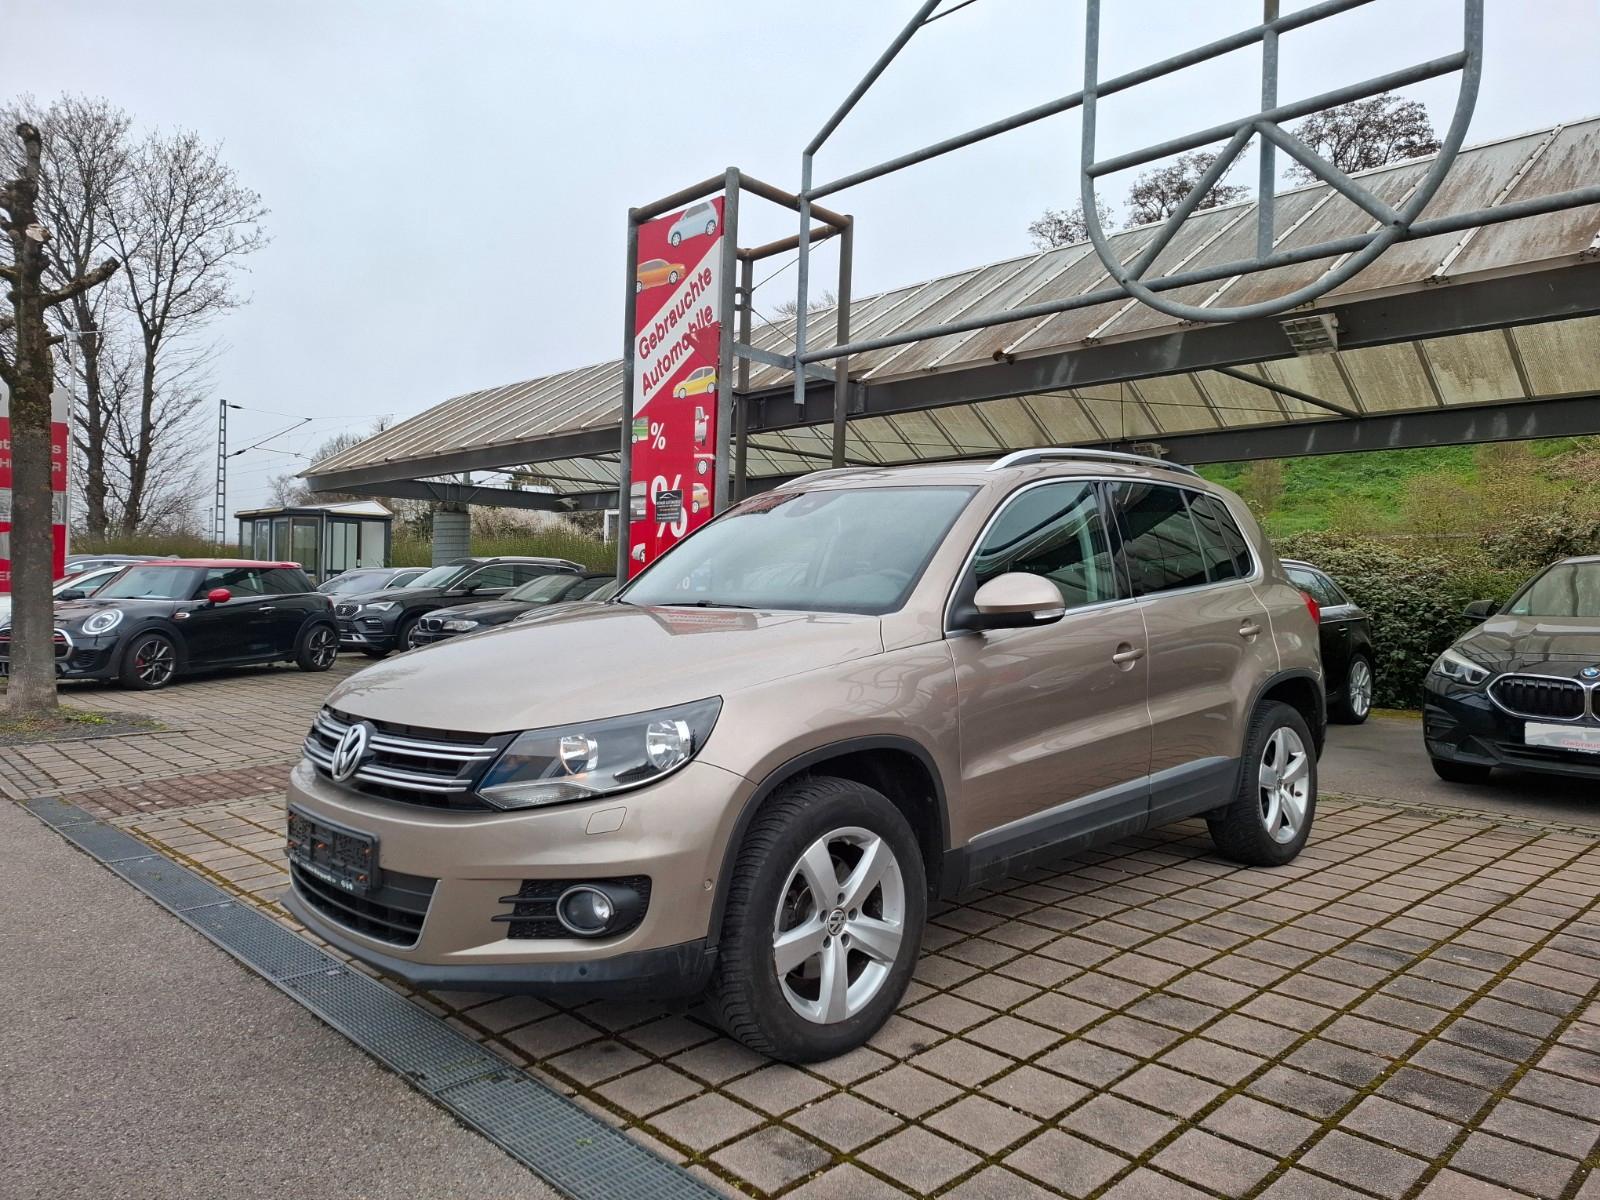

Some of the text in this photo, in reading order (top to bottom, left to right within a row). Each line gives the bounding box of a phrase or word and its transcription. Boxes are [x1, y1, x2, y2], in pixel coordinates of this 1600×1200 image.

[639, 267, 712, 360] Gebrauchte
[642, 305, 714, 396] Automobile
[651, 422, 666, 450] %
